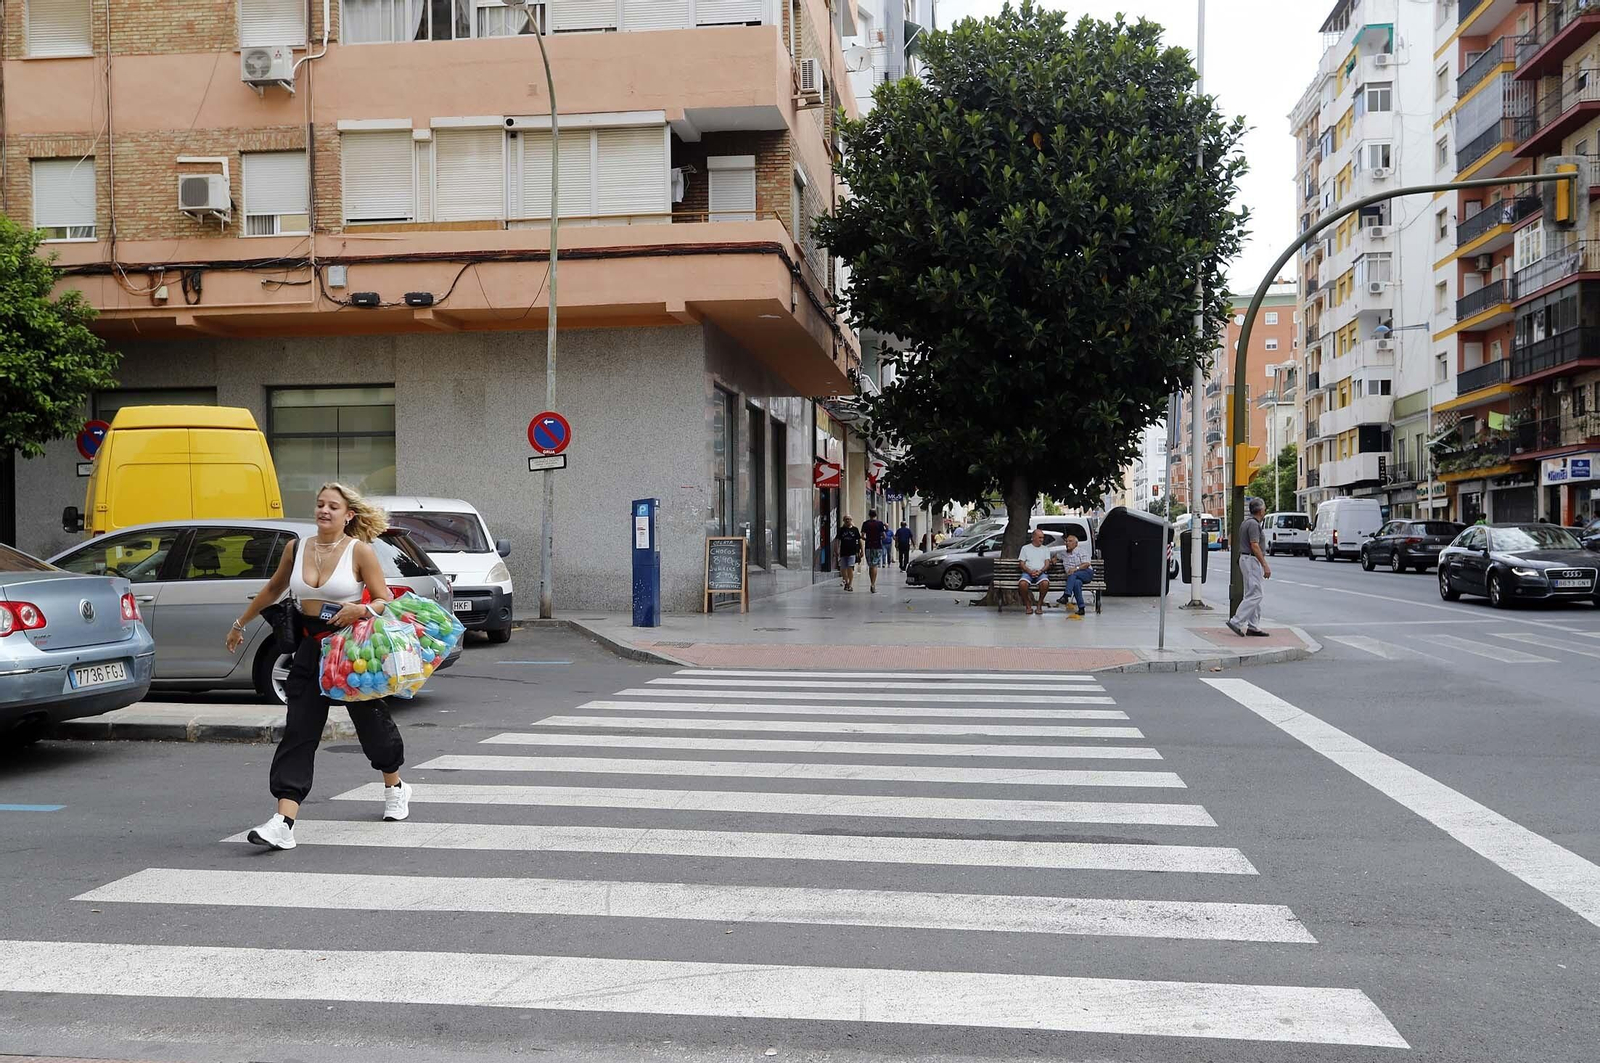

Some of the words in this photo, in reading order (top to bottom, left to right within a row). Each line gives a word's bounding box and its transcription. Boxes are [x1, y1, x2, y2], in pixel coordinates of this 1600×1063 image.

[639, 505, 646, 515] P
[454, 602, 469, 610] HKF
[76, 667, 104, 685] 7736
[104, 663, 124, 680] FGJ
